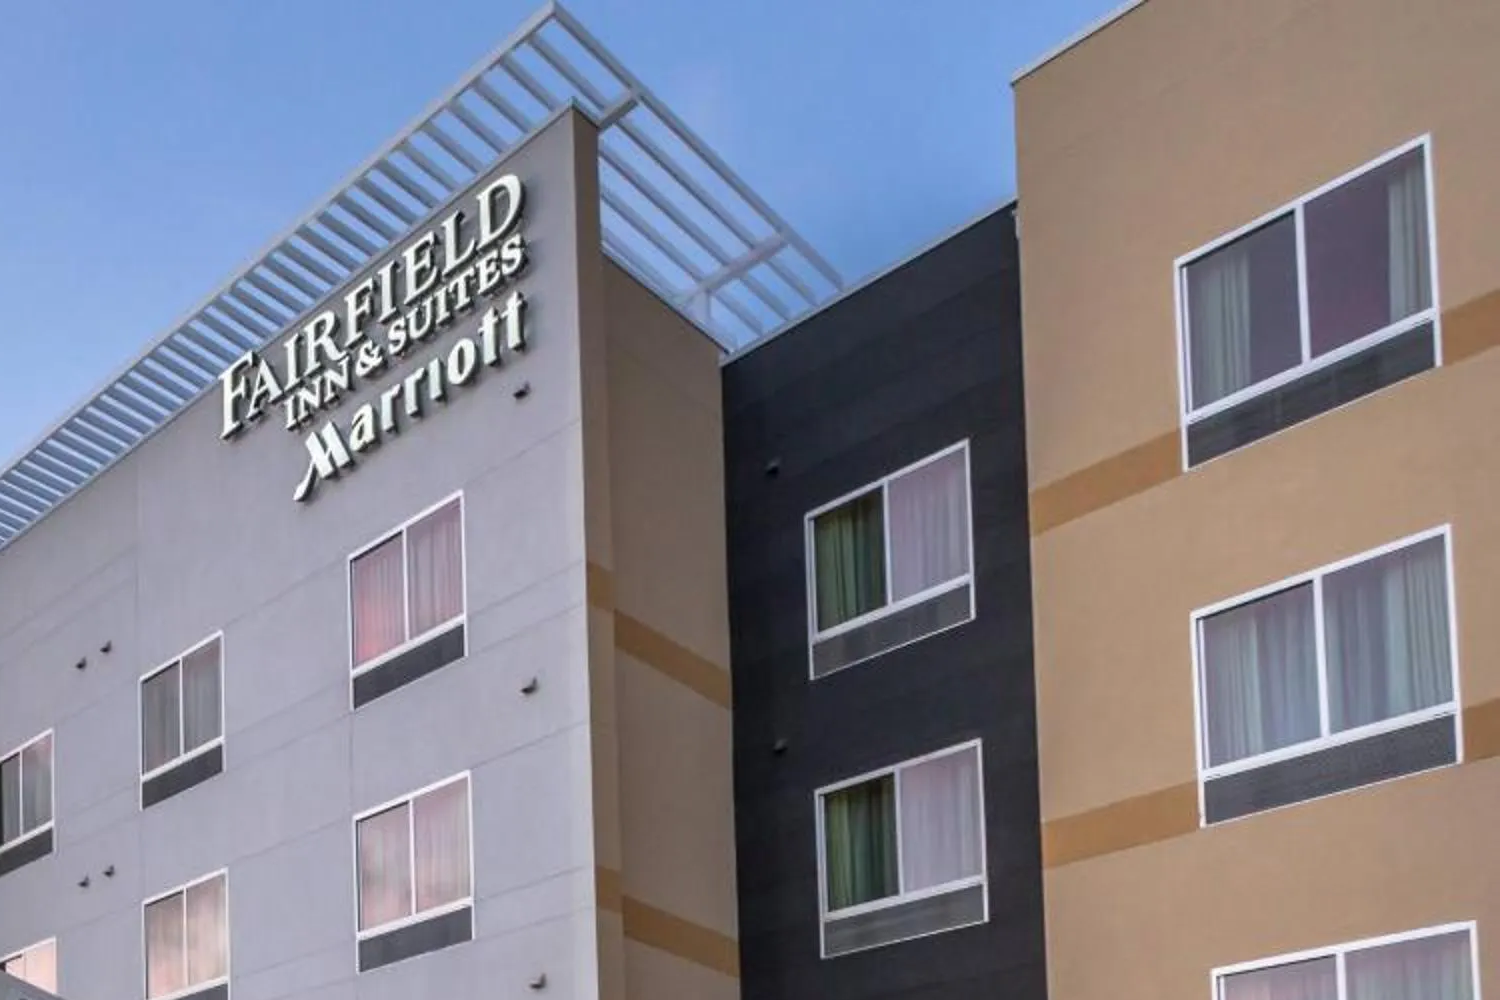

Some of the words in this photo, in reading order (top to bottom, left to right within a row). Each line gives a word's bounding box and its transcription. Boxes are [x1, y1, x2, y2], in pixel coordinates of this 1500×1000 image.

[219, 173, 524, 439] FAIRFIELD
[285, 356, 351, 430] INN
[356, 340, 385, 378] &
[388, 233, 527, 355] SUITES
[293, 290, 528, 502] Marriott
